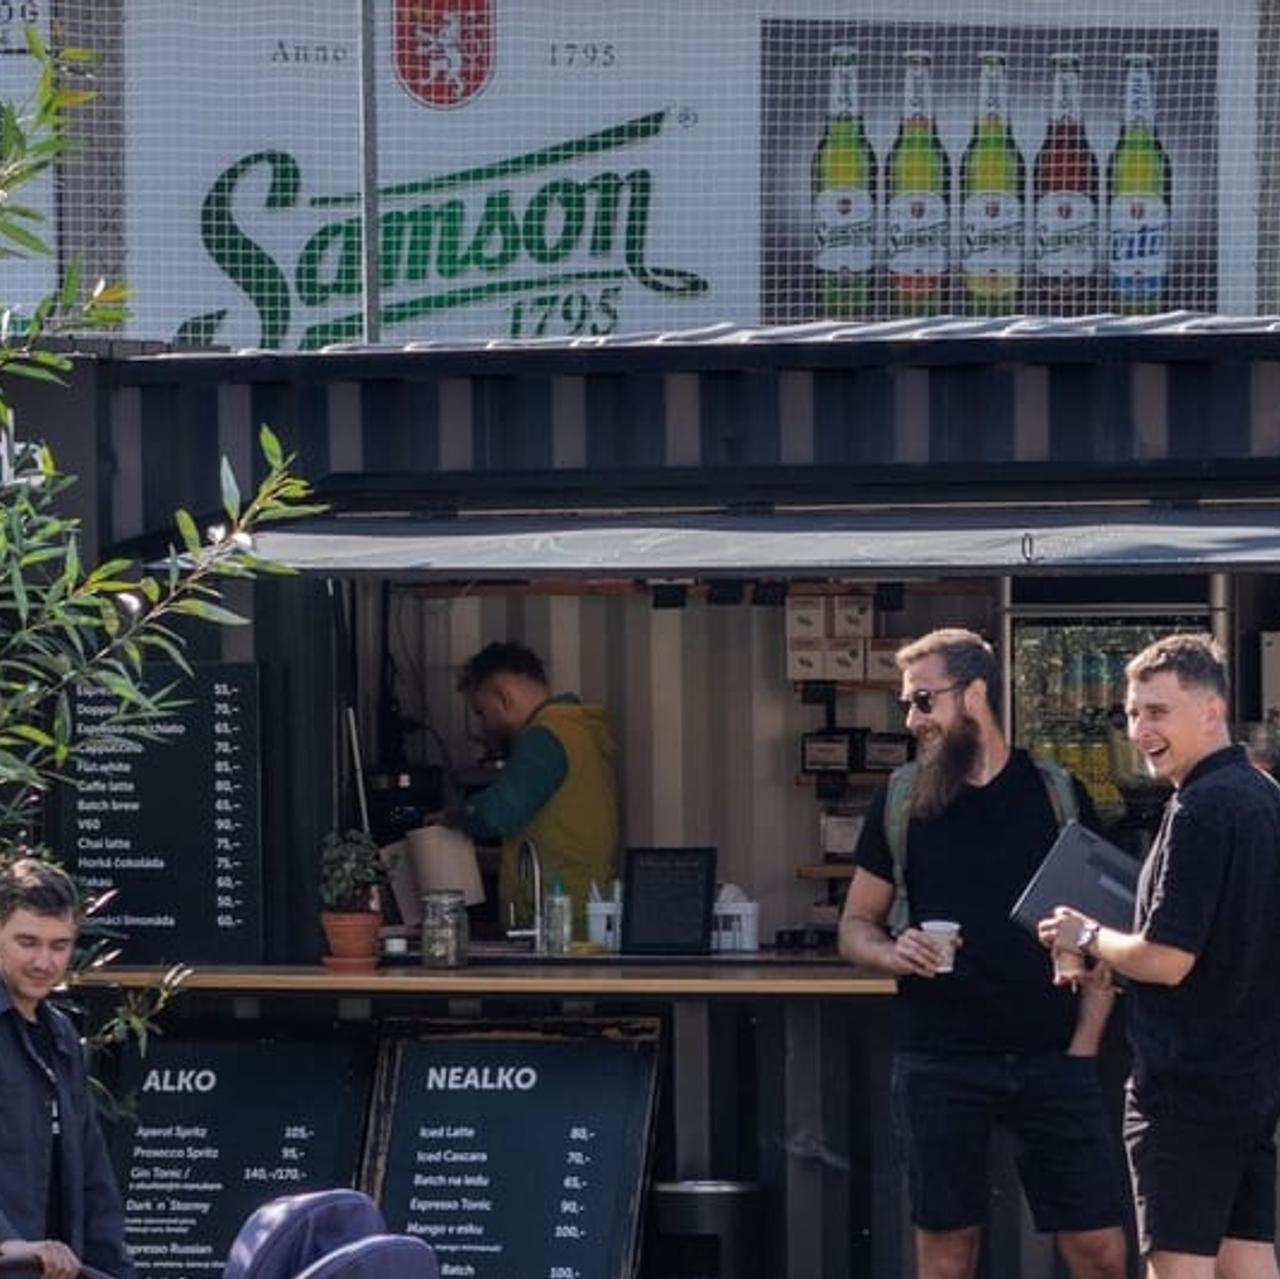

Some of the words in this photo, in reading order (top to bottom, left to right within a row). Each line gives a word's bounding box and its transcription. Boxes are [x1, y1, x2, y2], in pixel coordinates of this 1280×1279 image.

[271, 41, 348, 63] Anno
[549, 43, 617, 66] 1795
[508, 286, 622, 340] 1795
[77, 800, 109, 811] Batch
[111, 800, 141, 811] brew
[77, 837, 103, 849] Chai
[105, 837, 131, 849] latte
[141, 1067, 217, 1093] ALKO
[426, 1066, 538, 1090] NEALKO
[135, 1125, 173, 1139] Aperol
[175, 1125, 208, 1139] Spritz
[419, 1126, 445, 1138] Iced
[446, 1126, 476, 1138] Latte
[133, 1146, 185, 1160] Prosecco
[187, 1146, 220, 1160] Spritz
[417, 1150, 442, 1162] Iced
[443, 1150, 488, 1163] Cascara
[130, 1167, 152, 1179] Gin
[153, 1167, 183, 1179] Tonic
[414, 1174, 446, 1187] Batch
[447, 1176, 462, 1187] na
[126, 1199, 152, 1211] Dark
[169, 1199, 211, 1215] Stormy
[409, 1197, 460, 1213] Espresso
[461, 1197, 493, 1211] Tonic
[407, 1222, 447, 1237] Mango
[169, 1242, 213, 1255] Russian
[440, 1263, 476, 1276] Batch
